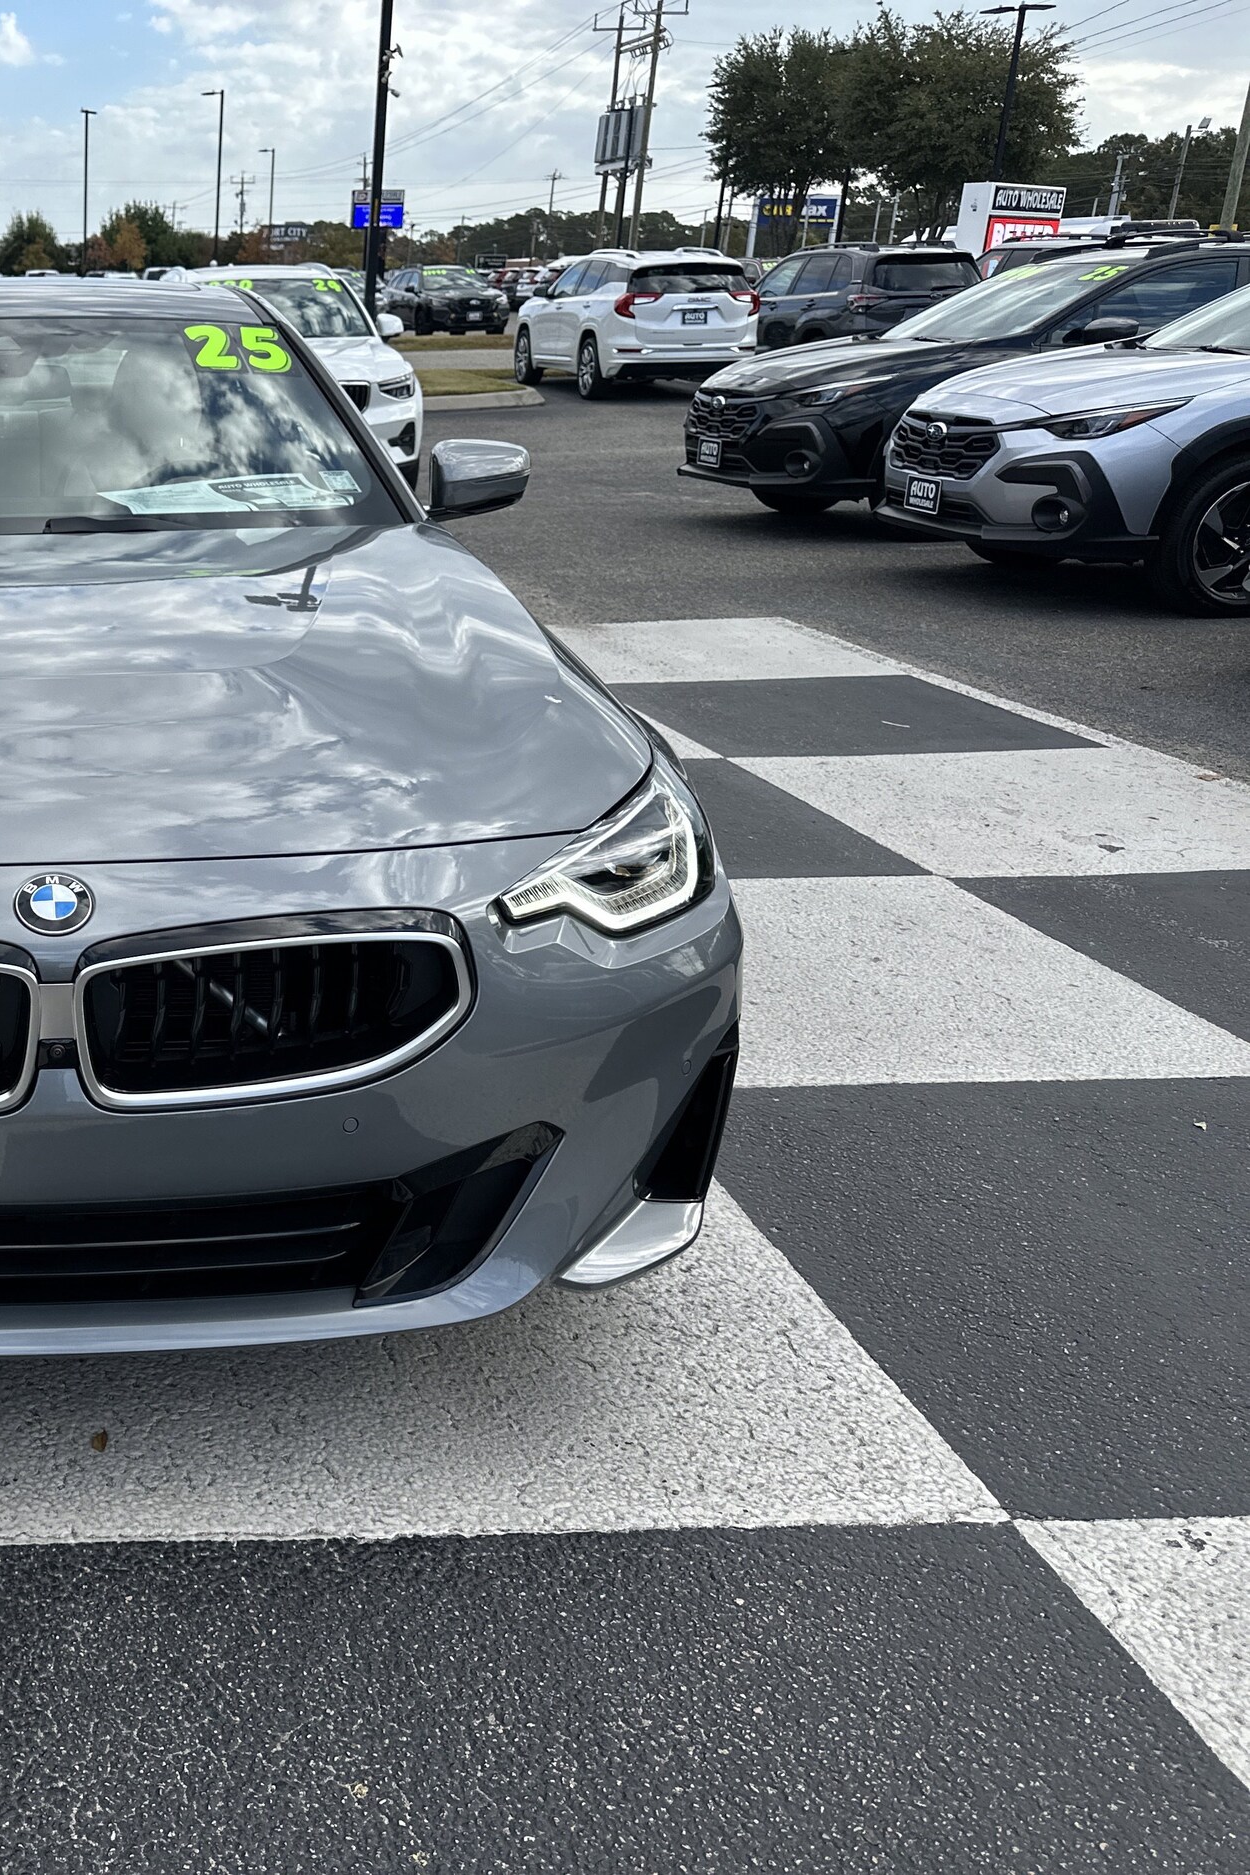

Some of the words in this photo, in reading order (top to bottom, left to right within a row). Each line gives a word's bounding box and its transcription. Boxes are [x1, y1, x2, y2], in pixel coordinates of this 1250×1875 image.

[996, 189, 1019, 207] AUTO
[1020, 190, 1063, 209] WHOLESALE
[287, 226, 307, 237] CITY
[1078, 265, 1129, 281] 25
[684, 312, 705, 320] AUTO
[183, 324, 292, 373] 25
[700, 441, 718, 456] AUTO
[243, 480, 295, 488] WHOLESALE
[910, 480, 936, 499] AUTO
[23, 876, 84, 894] BMW
